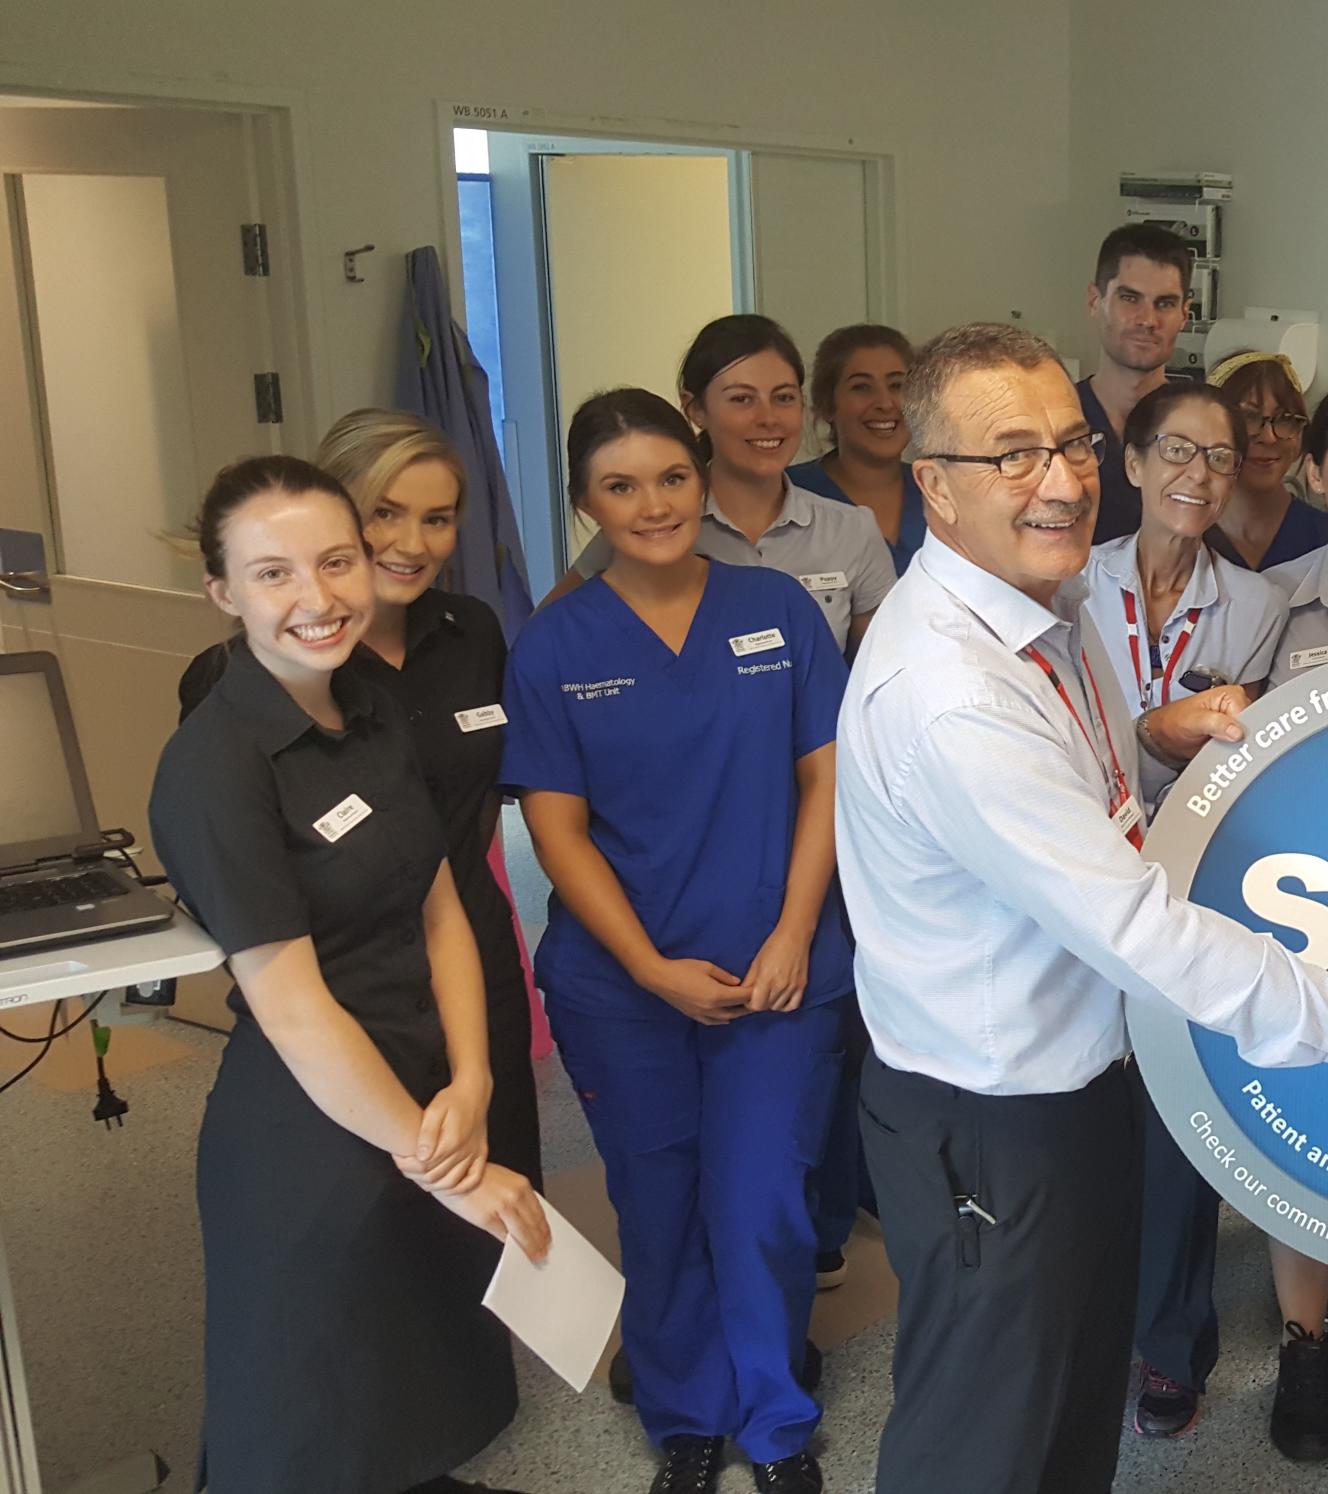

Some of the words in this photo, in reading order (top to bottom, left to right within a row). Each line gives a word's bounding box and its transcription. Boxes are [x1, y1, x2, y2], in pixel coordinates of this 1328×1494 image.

[748, 633, 776, 642] Charlotte
[1309, 649, 1328, 657] Jessica
[737, 661, 781, 675] Registered
[585, 678, 635, 691] Haematology
[576, 692, 585, 700] &
[586, 690, 602, 699] BMT
[604, 687, 620, 697] Unit
[1186, 743, 1254, 817] Better
[1255, 706, 1309, 748] care
[1241, 1079, 1308, 1151] Patient
[1189, 1111, 1236, 1169] Check
[1234, 1166, 1267, 1196] our
